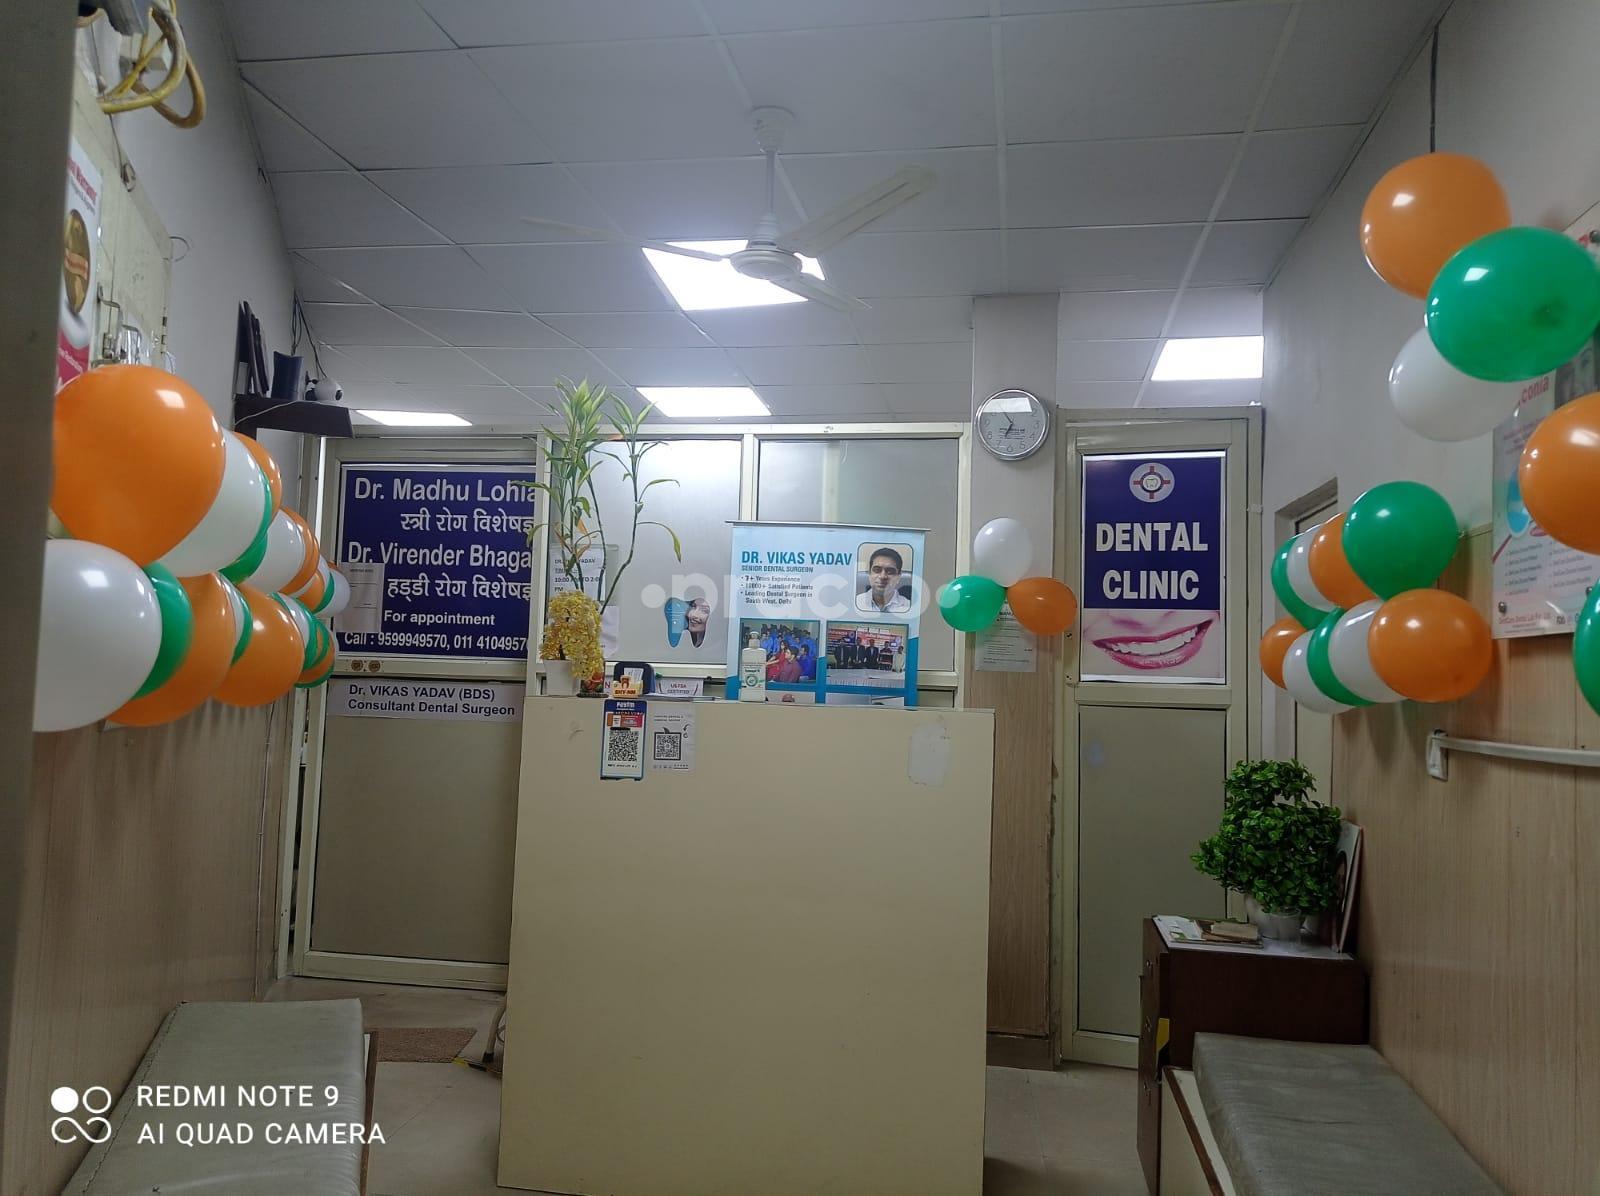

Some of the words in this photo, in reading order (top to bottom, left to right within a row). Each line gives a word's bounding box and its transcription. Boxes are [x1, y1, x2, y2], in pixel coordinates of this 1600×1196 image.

[354, 477, 385, 499] Dr.
[392, 478, 469, 501] Madhu
[400, 507, 430, 532] स्त्री
[436, 507, 467, 533] रोग
[1095, 522, 1209, 552] DENTAL
[347, 541, 372, 563] Dr.
[380, 542, 464, 567] Virender
[741, 550, 763, 564] DR.
[767, 551, 805, 565] VIKAS
[809, 552, 853, 566] YADAV
[763, 565, 785, 573] DENTAL
[435, 572, 467, 598] रोग
[1102, 569, 1200, 601] CLINIC
[384, 610, 407, 622] For
[410, 611, 496, 627] appointment
[344, 631, 367, 645] Call
[377, 631, 450, 651] 9599949570,
[453, 634, 473, 649] 011
[348, 683, 367, 696] Dr.
[370, 685, 409, 697] VIKAS
[413, 686, 455, 699] YADAV
[458, 687, 496, 703] (BDS)
[348, 698, 416, 713] Consultant
[418, 700, 459, 714] Dental
[461, 702, 516, 717] Surgeon
